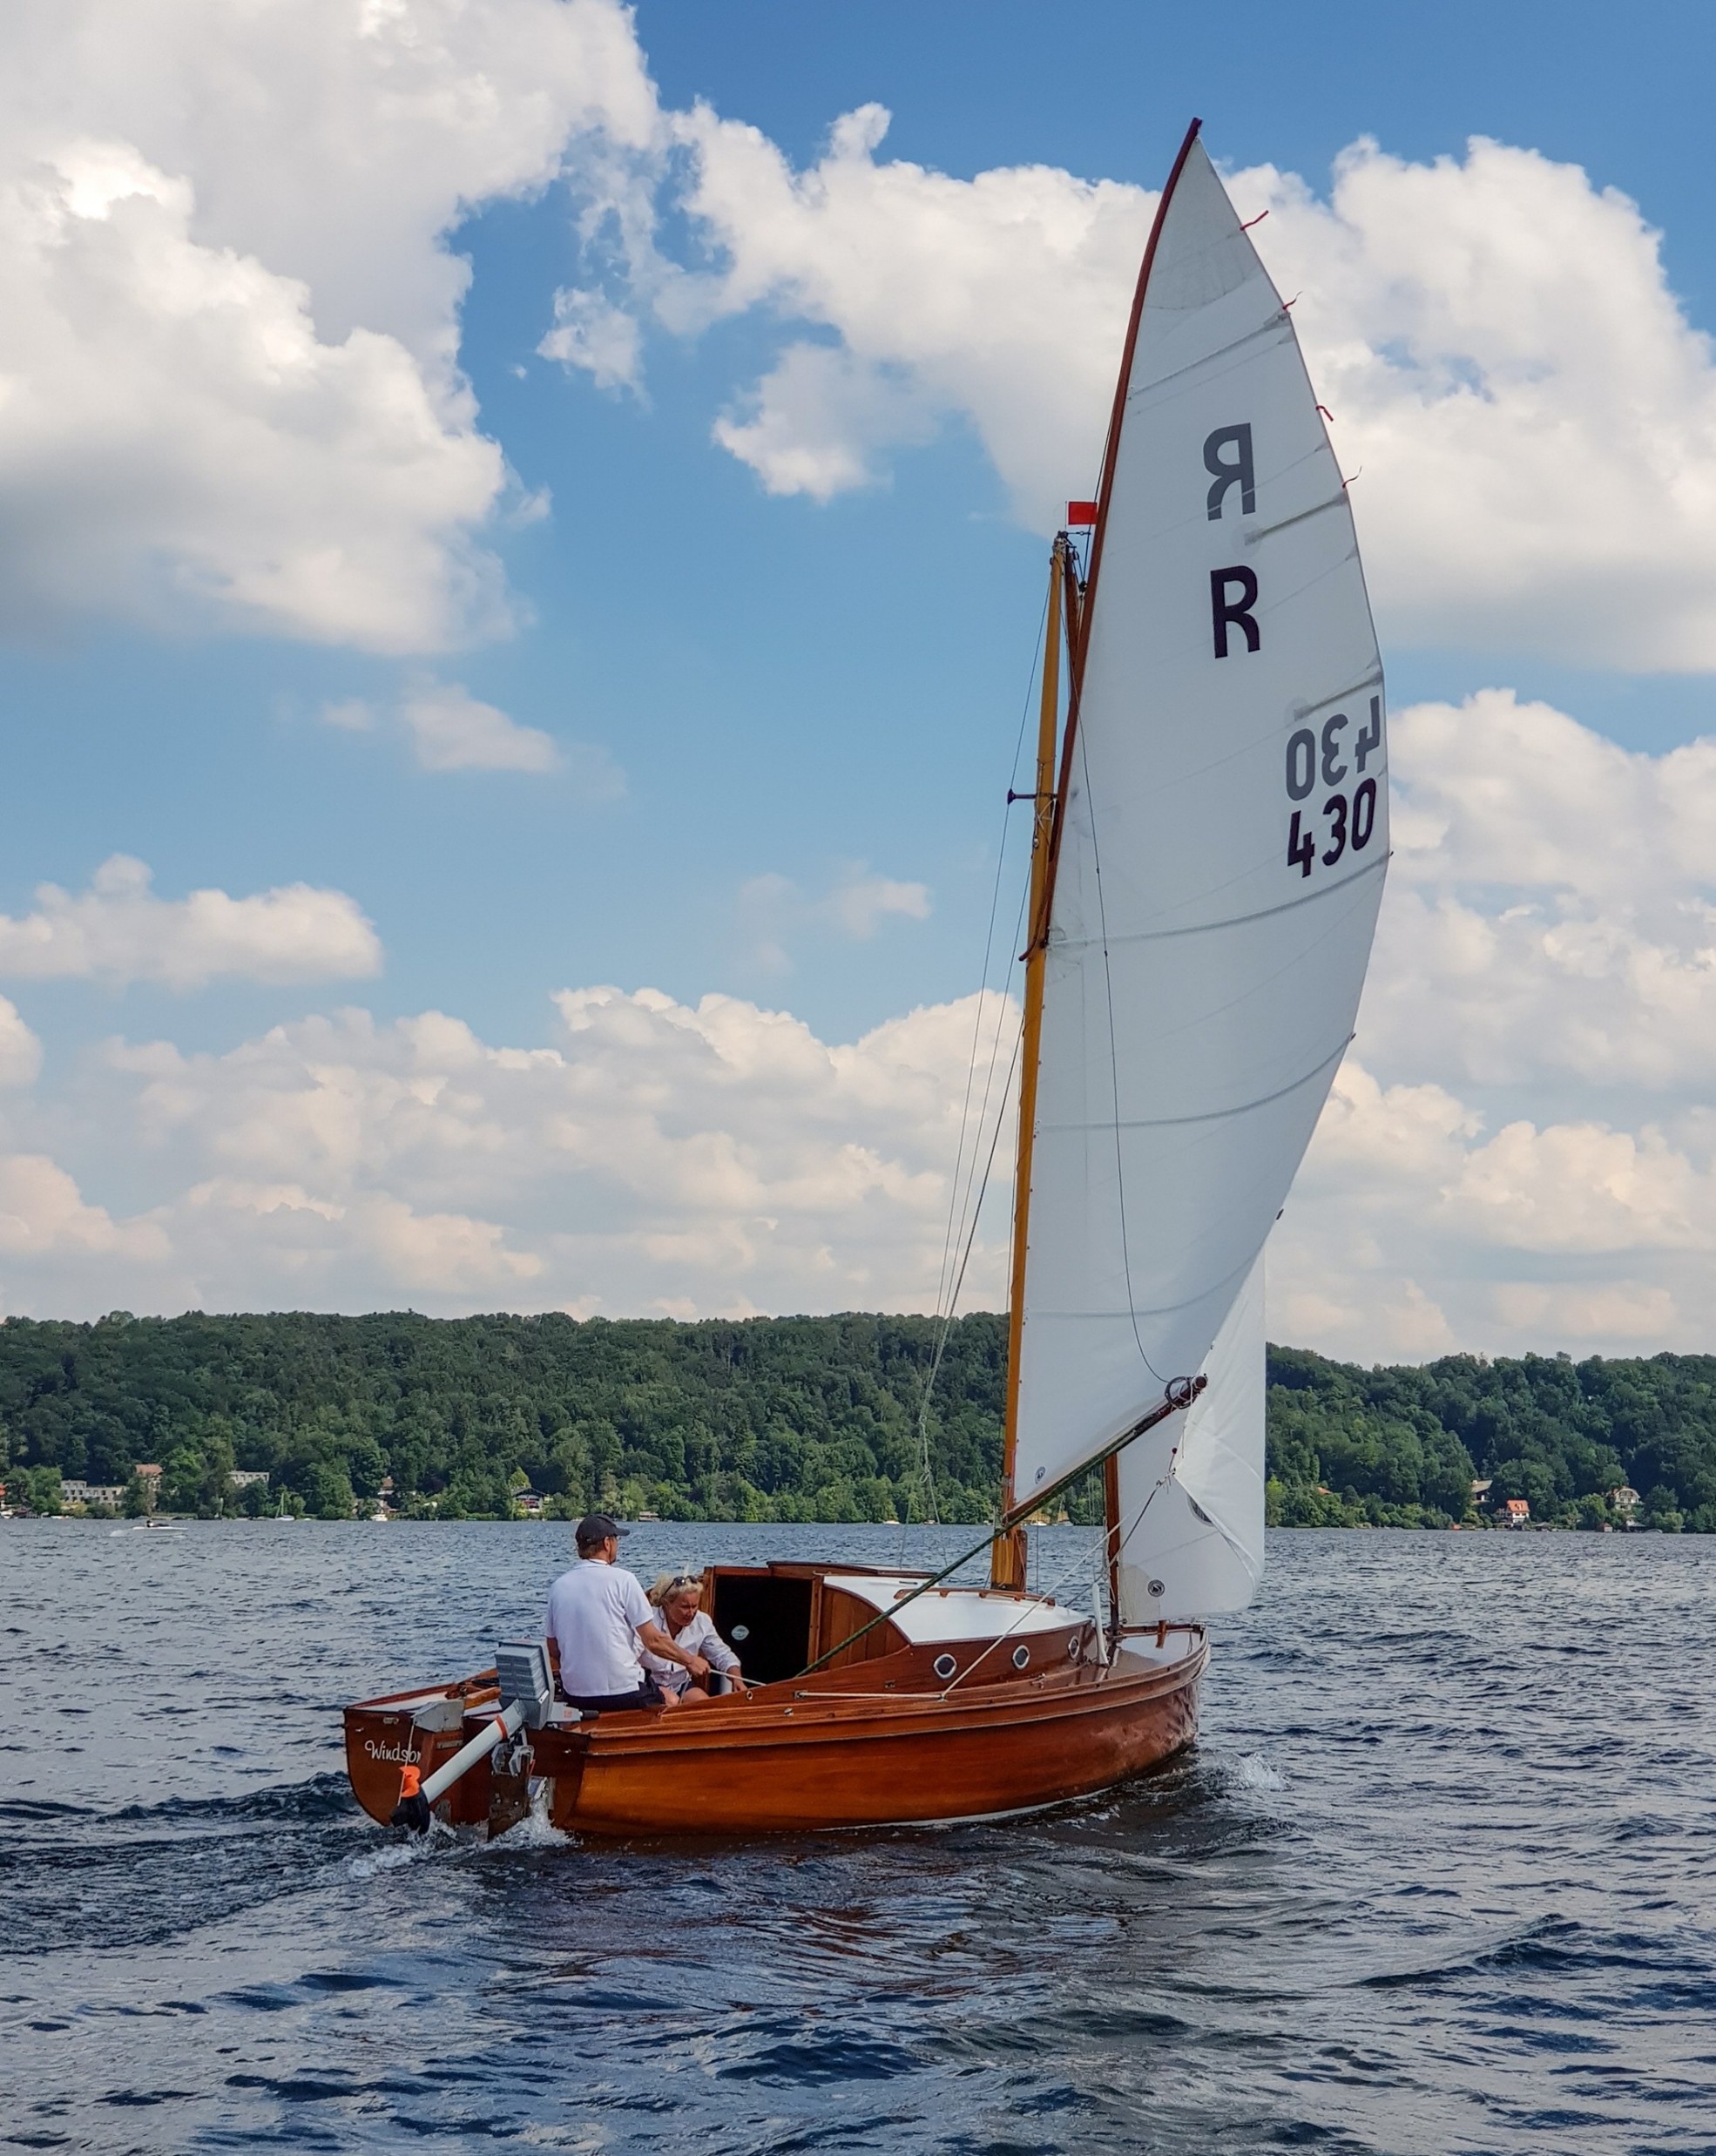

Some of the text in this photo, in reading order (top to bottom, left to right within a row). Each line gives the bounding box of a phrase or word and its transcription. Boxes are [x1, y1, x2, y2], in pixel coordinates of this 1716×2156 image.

[1210, 564, 1260, 659] R
[1287, 777, 1376, 878] 430
[364, 1740, 422, 1763] Windsor
